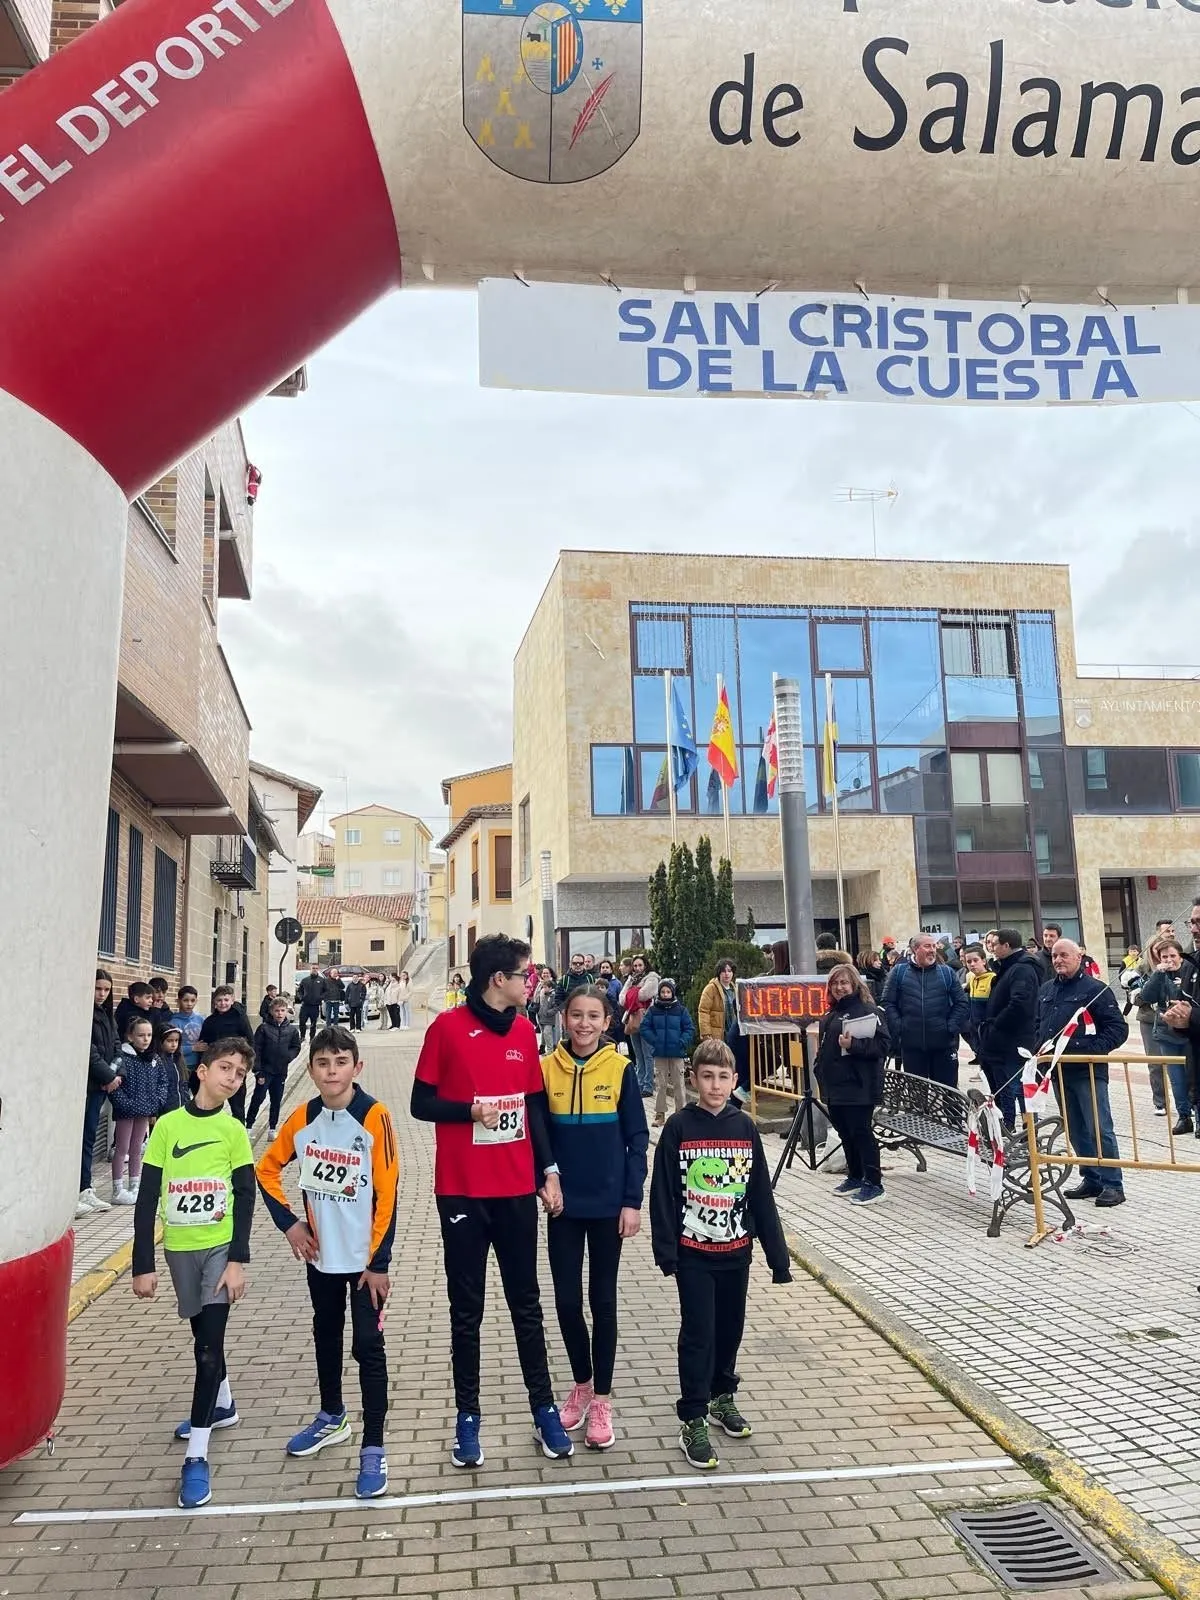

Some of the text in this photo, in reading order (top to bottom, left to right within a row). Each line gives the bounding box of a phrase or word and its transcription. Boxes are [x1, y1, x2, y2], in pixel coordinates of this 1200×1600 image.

[709, 52, 804, 148] de
[0, 143, 73, 206] EL
[618, 300, 1161, 357] SAN CRISTOBAL
[647, 347, 1138, 401] DE LA CUESTA
[493, 1112, 518, 1131] 83
[305, 1145, 361, 1166] bedunia
[679, 1148, 753, 1160] TYRANNOSAURUS
[313, 1162, 347, 1184] 429
[168, 1180, 226, 1194] bedunia
[176, 1194, 215, 1214] 428
[697, 1207, 729, 1228] 423
